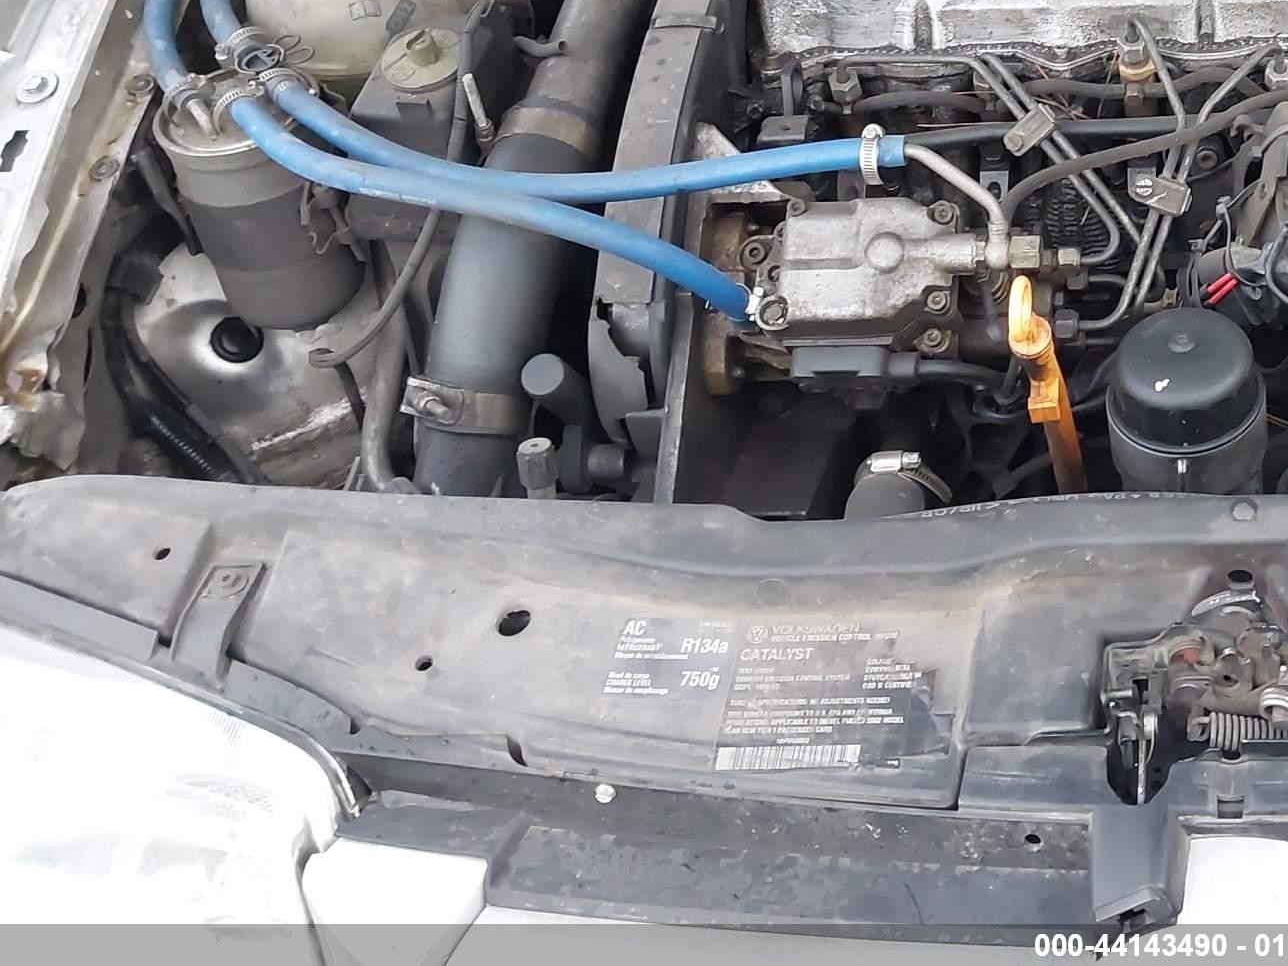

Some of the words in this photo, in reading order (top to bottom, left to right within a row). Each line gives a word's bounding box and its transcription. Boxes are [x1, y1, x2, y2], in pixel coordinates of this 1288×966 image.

[623, 620, 647, 636] AC
[772, 623, 860, 635] VOLKSWAGEN
[680, 638, 729, 655] R134a
[740, 647, 815, 662] CATALYST
[680, 671, 720, 690] 750g
